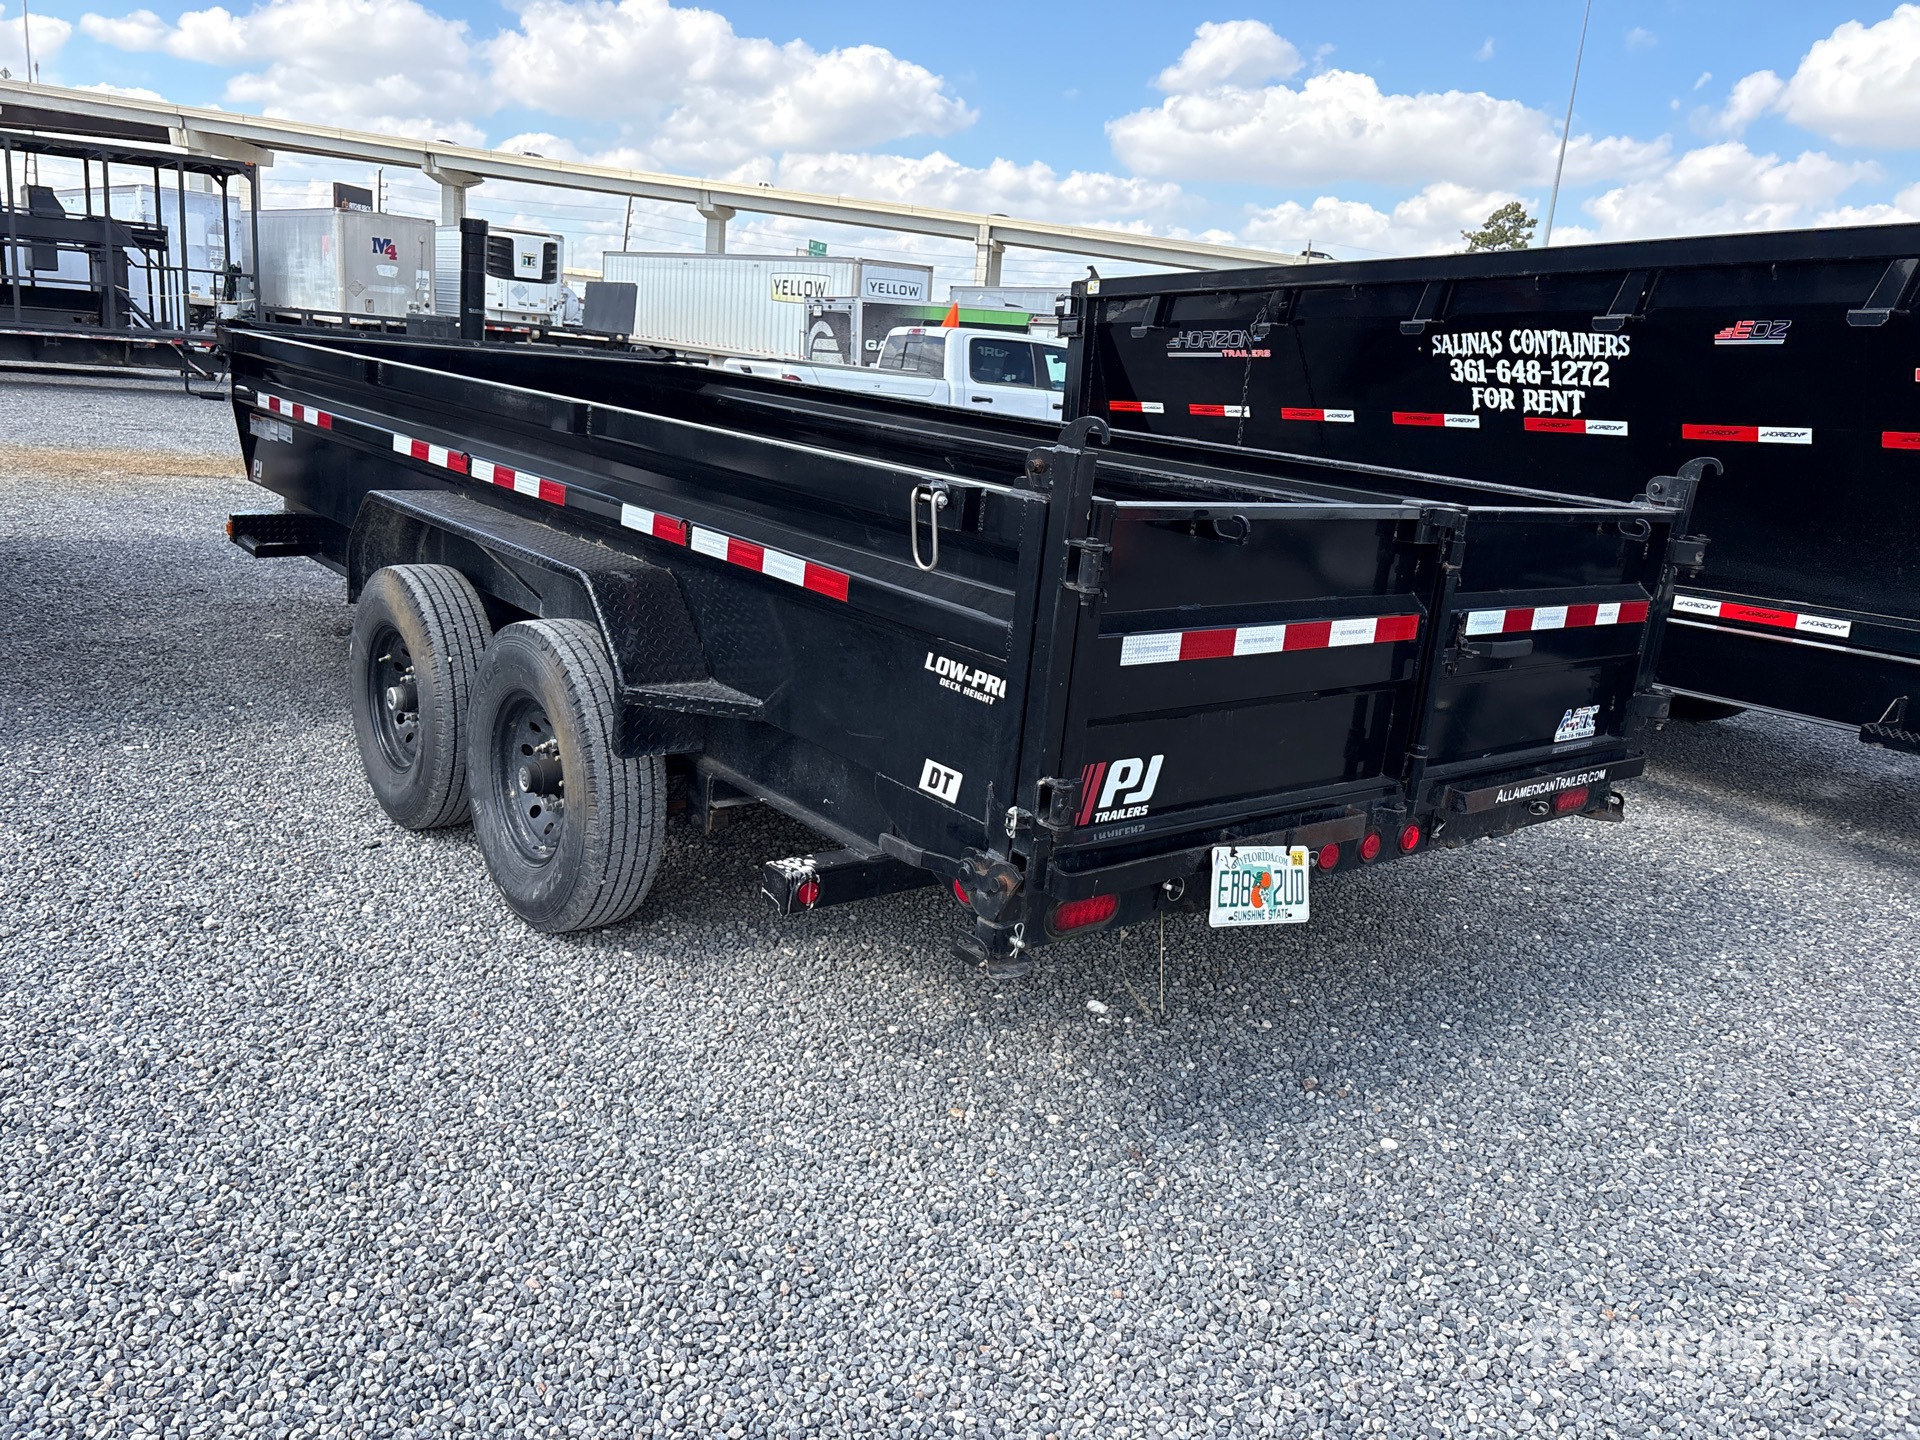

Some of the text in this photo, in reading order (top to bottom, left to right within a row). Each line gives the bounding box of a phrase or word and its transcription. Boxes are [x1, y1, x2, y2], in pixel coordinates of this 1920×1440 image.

[371, 236, 398, 261] M4
[773, 278, 826, 298] YELLOW
[869, 281, 920, 297] YELLOW
[1431, 328, 1631, 360] SALINAS CONTAINERS
[1449, 358, 1610, 389] 361-648-1272
[1471, 386, 1586, 417] FOR RENT
[938, 677, 996, 706] DECK HEIGHT
[926, 765, 955, 796] DT
[1097, 754, 1165, 809] PJ
[1094, 804, 1150, 824] TRAILERS
[1233, 908, 1289, 922] SUNSHINE STATE
